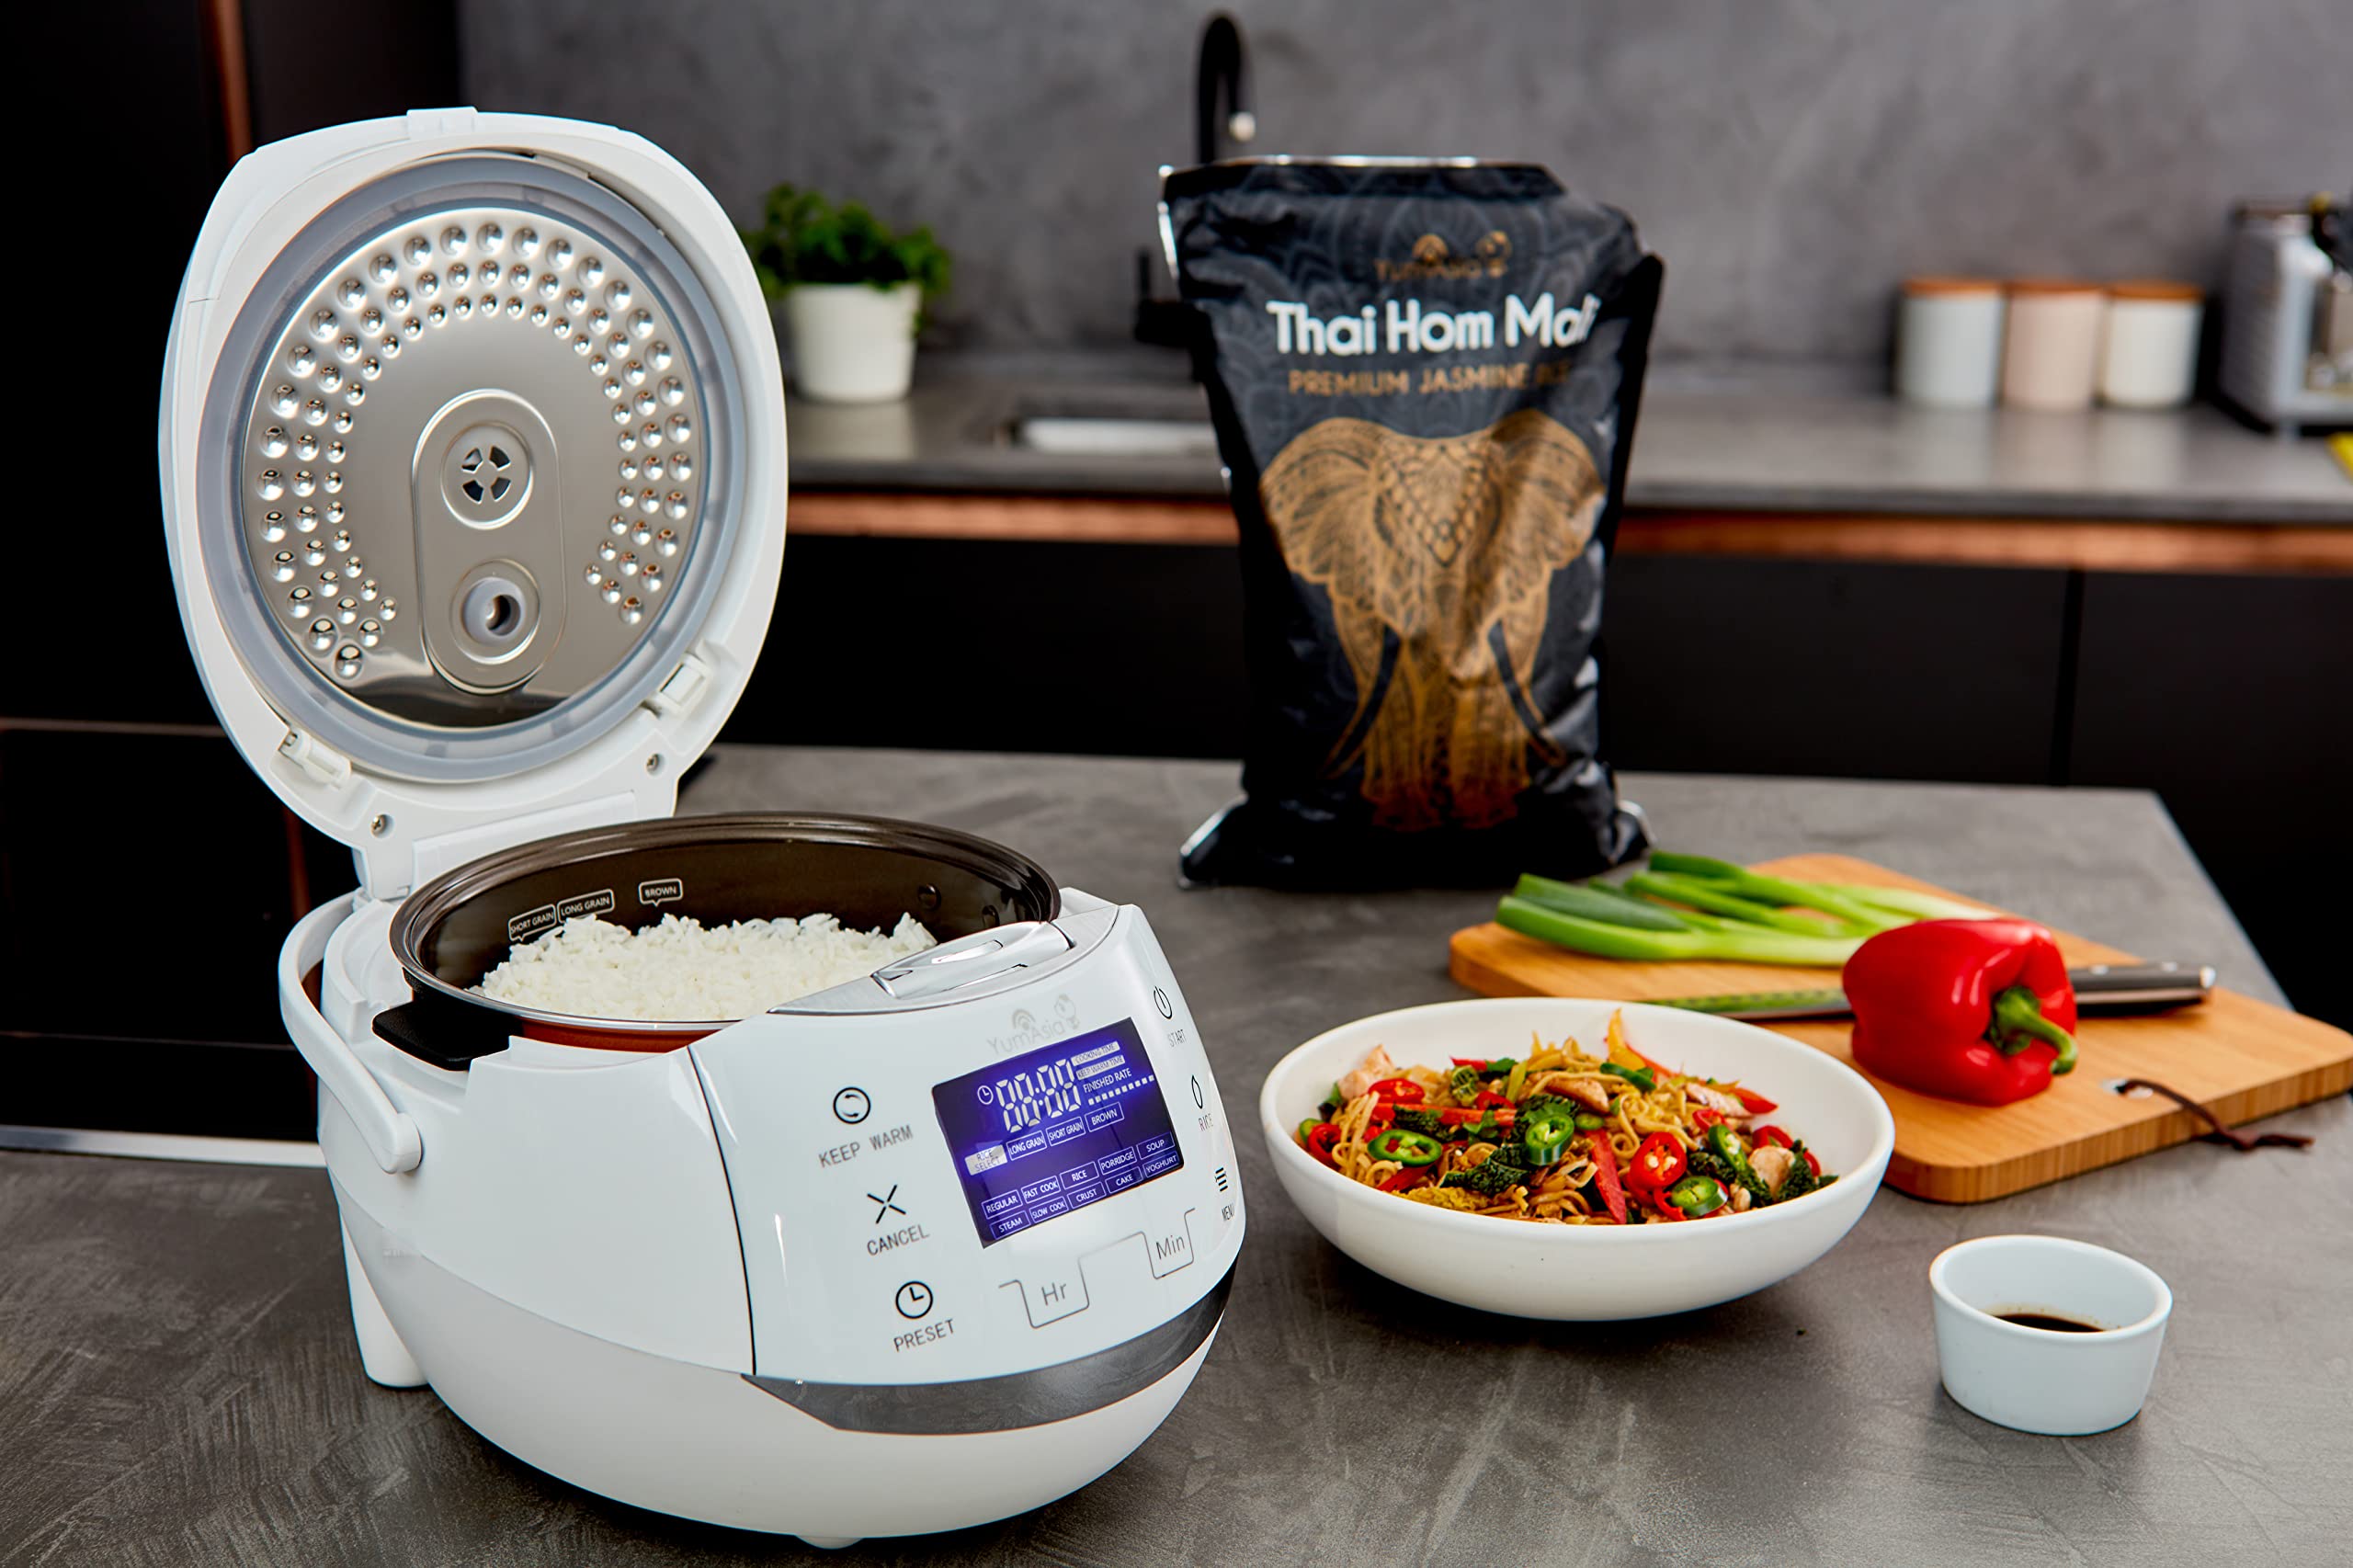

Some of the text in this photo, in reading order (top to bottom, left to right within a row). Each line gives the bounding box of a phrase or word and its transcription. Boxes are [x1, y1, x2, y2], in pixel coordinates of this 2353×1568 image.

[1266, 300, 1377, 356] Thai
[1385, 298, 1495, 353] Hom
[1289, 369, 1409, 396] PREMIUM
[1418, 362, 1530, 394] JASMINE
[644, 885, 676, 898] BROWN
[561, 896, 610, 917] LONG GRAIN
[510, 911, 554, 934] SHORT GRAIN
[1167, 1028, 1188, 1047] START
[1074, 1043, 1116, 1064] COOKING TIME
[1077, 1056, 1123, 1078] KEEP WARM TIME
[1083, 1068, 1132, 1094] FINISHED RATE
[1091, 1108, 1118, 1126] BROWN
[1199, 1113, 1214, 1131] RICE
[1048, 1121, 1084, 1142] SHORT GRAIN
[818, 1124, 914, 1168] KEEP WARM
[1010, 1135, 1045, 1156] LONG GRAIN
[1146, 1139, 1165, 1153] SOUP
[974, 1148, 1001, 1173] RICE SELECT
[1101, 1152, 1134, 1170] PORRIDGE
[1145, 1155, 1177, 1174] YOGHURT
[1072, 1169, 1087, 1182] RICE
[1116, 1174, 1133, 1187] CAKE
[1024, 1180, 1059, 1200] FAST COOK
[1076, 1188, 1098, 1203] CRUST
[985, 1195, 1018, 1214] REGULAR
[1032, 1200, 1066, 1220] SLOW COOK
[1222, 1203, 1235, 1221] MENU
[998, 1217, 1023, 1233] STEAM
[867, 1223, 930, 1256] CANCEL
[1155, 1234, 1186, 1260] Min
[1040, 1282, 1067, 1306] Hr
[893, 1318, 956, 1352] PRESET
